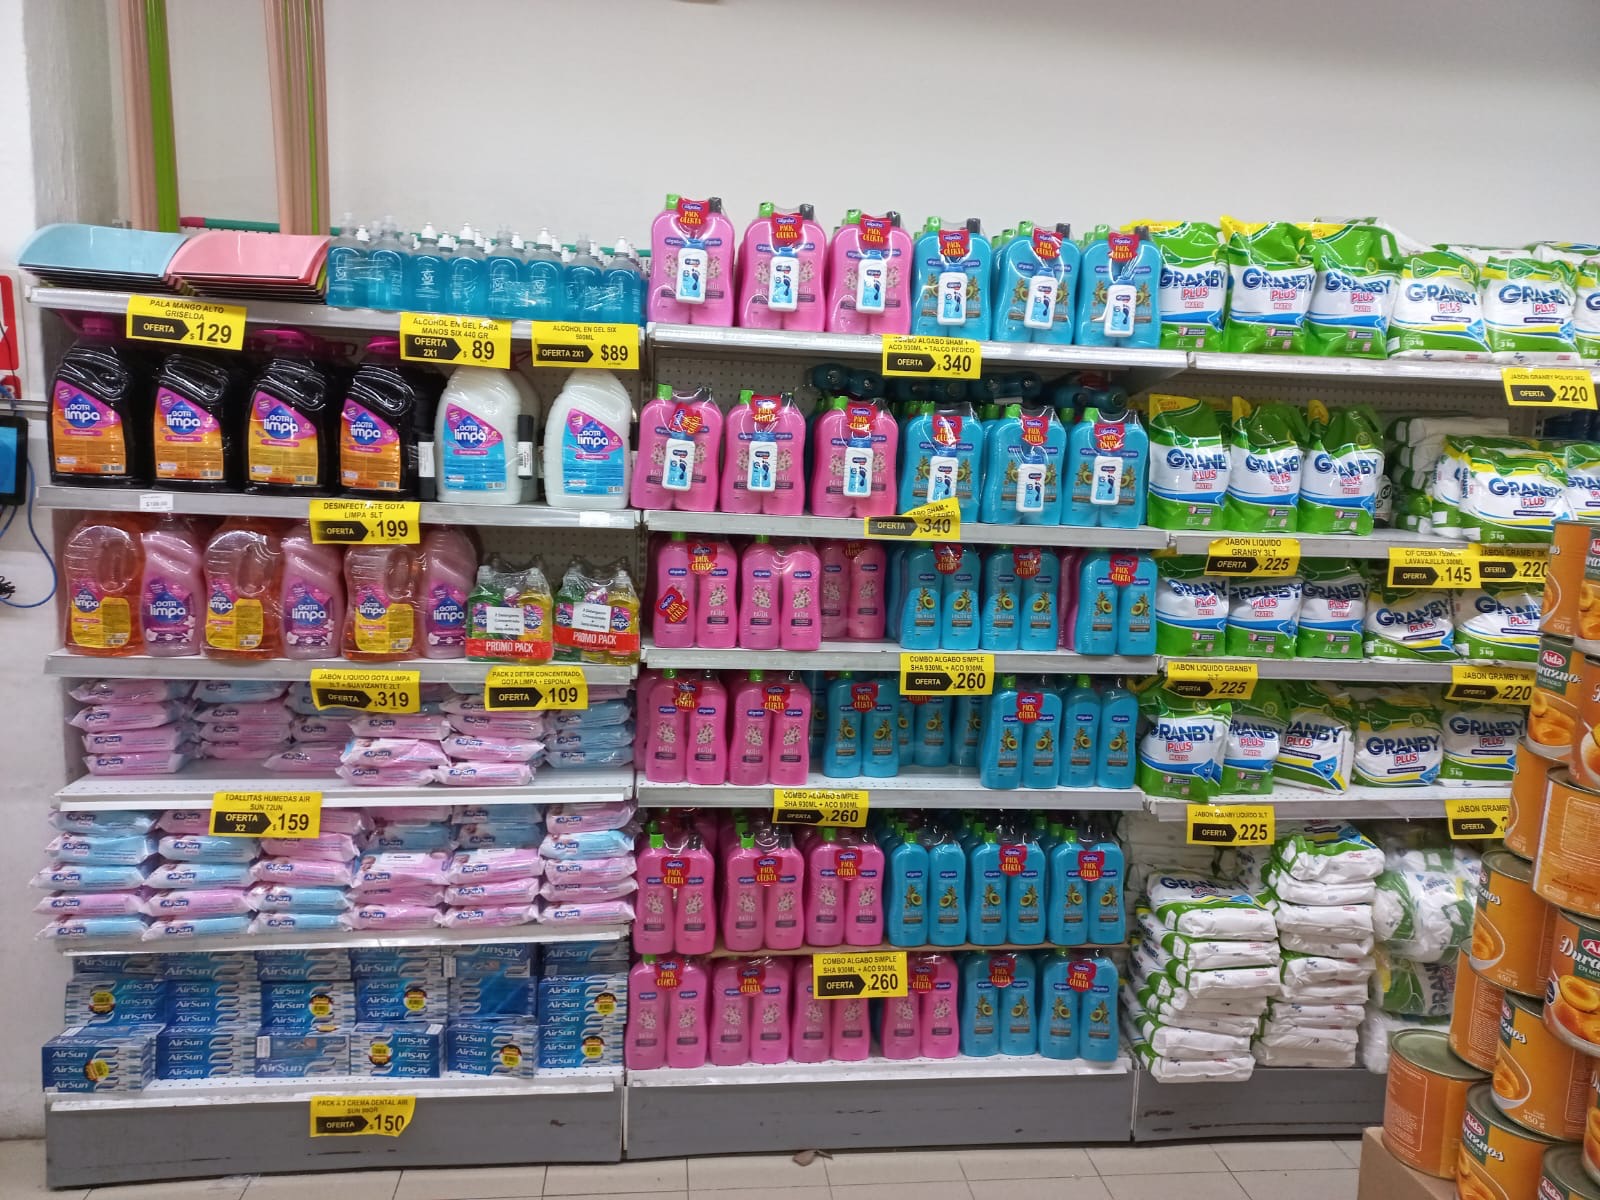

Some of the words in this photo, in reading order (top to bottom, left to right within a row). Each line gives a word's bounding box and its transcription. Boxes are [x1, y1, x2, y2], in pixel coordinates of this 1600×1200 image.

[1160, 267, 1226, 289] GRANBY
[1242, 268, 1316, 292] GRANBY
[1325, 270, 1391, 294] GRANBY
[1181, 286, 1209, 300] PLUS
[1270, 287, 1297, 300] PLUS
[1351, 291, 1375, 303] PLUS
[149, 299, 170, 308] PALA
[172, 301, 201, 311] MANGO
[203, 304, 224, 314] ALTO
[1438, 302, 1462, 314] PLUS
[1533, 303, 1557, 315] PLUS
[143, 322, 175, 333] OFERTA
[450, 319, 461, 328] EN
[462, 320, 478, 330] GEL
[421, 327, 450, 337] MANOS
[450, 328, 462, 337] SIX
[414, 336, 448, 348] OFERTA
[423, 348, 438, 358] 2X1
[541, 348, 571, 357] OFERTA
[571, 349, 585, 358] 2X1
[600, 343, 628, 362] $89
[897, 358, 923, 367] OFERTA
[1519, 390, 1546, 398] OFERTA
[64, 407, 101, 423] limpa
[166, 414, 201, 429] limpa
[350, 424, 382, 440] limpa
[577, 433, 608, 448] limpa
[1192, 469, 1217, 481] PLUS
[1521, 497, 1545, 508] PLUS
[344, 511, 367, 519] LIMPA
[326, 527, 354, 535] OFERTA
[877, 521, 906, 530] OFERTA
[1217, 560, 1247, 569] OFERTA
[1484, 566, 1506, 574] OFERTA
[1402, 572, 1427, 580] OFERTA
[1251, 597, 1277, 609] PLUS
[150, 605, 186, 618] limpa
[291, 608, 327, 622] limpa
[433, 609, 465, 623] limpa
[1408, 619, 1436, 633] PLUS
[572, 632, 597, 644] PROMO
[598, 633, 617, 645] PACK
[485, 641, 513, 652] PROMO
[514, 642, 534, 653] PACK
[1542, 652, 1563, 665] Aida
[327, 693, 360, 703] OFERTA
[498, 693, 530, 701] OFERTA
[1449, 716, 1524, 737] GRANBY
[1166, 741, 1194, 753] PLUS
[1239, 737, 1265, 748] PLUS
[1286, 736, 1314, 748] PLUS
[1366, 734, 1441, 755] GRANBY
[1480, 735, 1505, 748] PLUS
[1394, 752, 1419, 766] PLUS
[263, 794, 297, 803] HUMEDAS
[225, 813, 258, 822] OFERTA
[234, 823, 246, 832] X2
[1201, 828, 1227, 837] OFERTA
[1461, 823, 1486, 831] OFERTA
[826, 980, 855, 990] OFERTA
[326, 1121, 355, 1129] OFERTA
